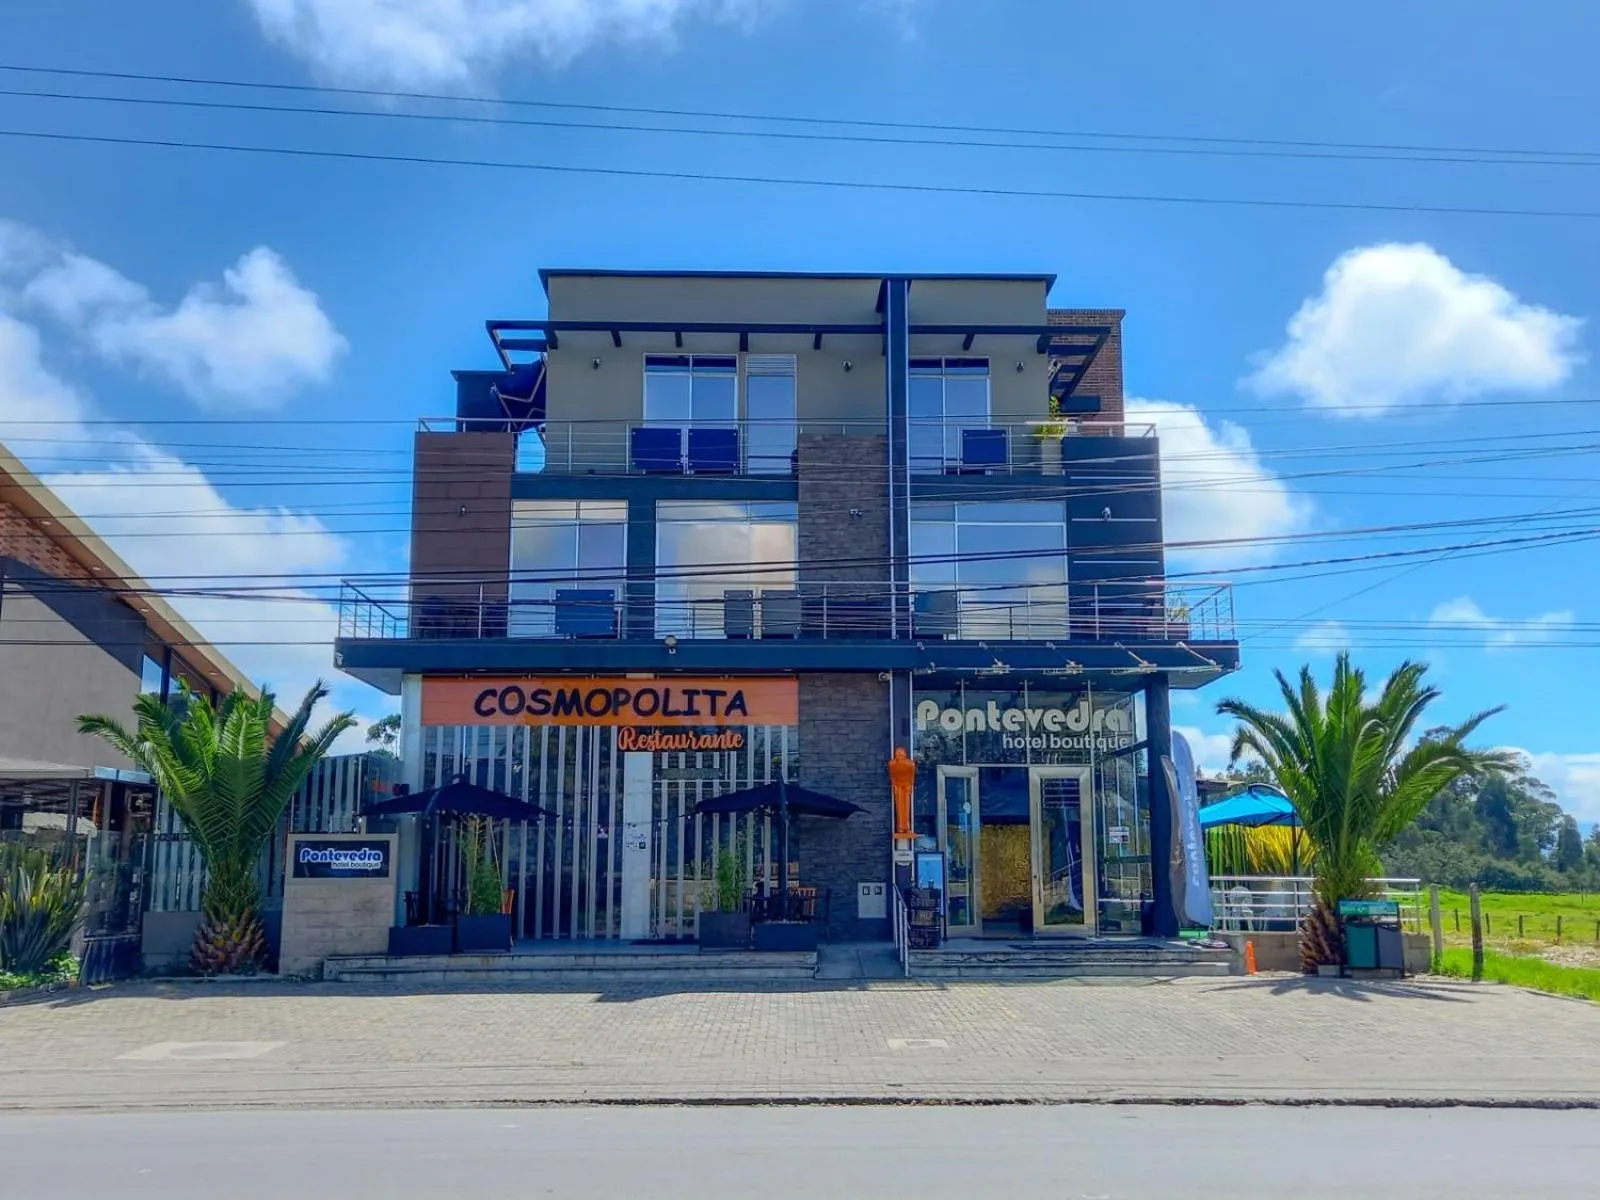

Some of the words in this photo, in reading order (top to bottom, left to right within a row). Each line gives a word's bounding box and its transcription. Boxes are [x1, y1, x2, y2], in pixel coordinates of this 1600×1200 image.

[474, 686, 748, 717] COSMOPOLITA
[917, 700, 1129, 731] Pontevedra
[618, 727, 744, 751] Restaurante
[1003, 734, 1046, 749] hotel
[1050, 734, 1130, 752] boutique
[300, 848, 383, 862] Pontevedra
